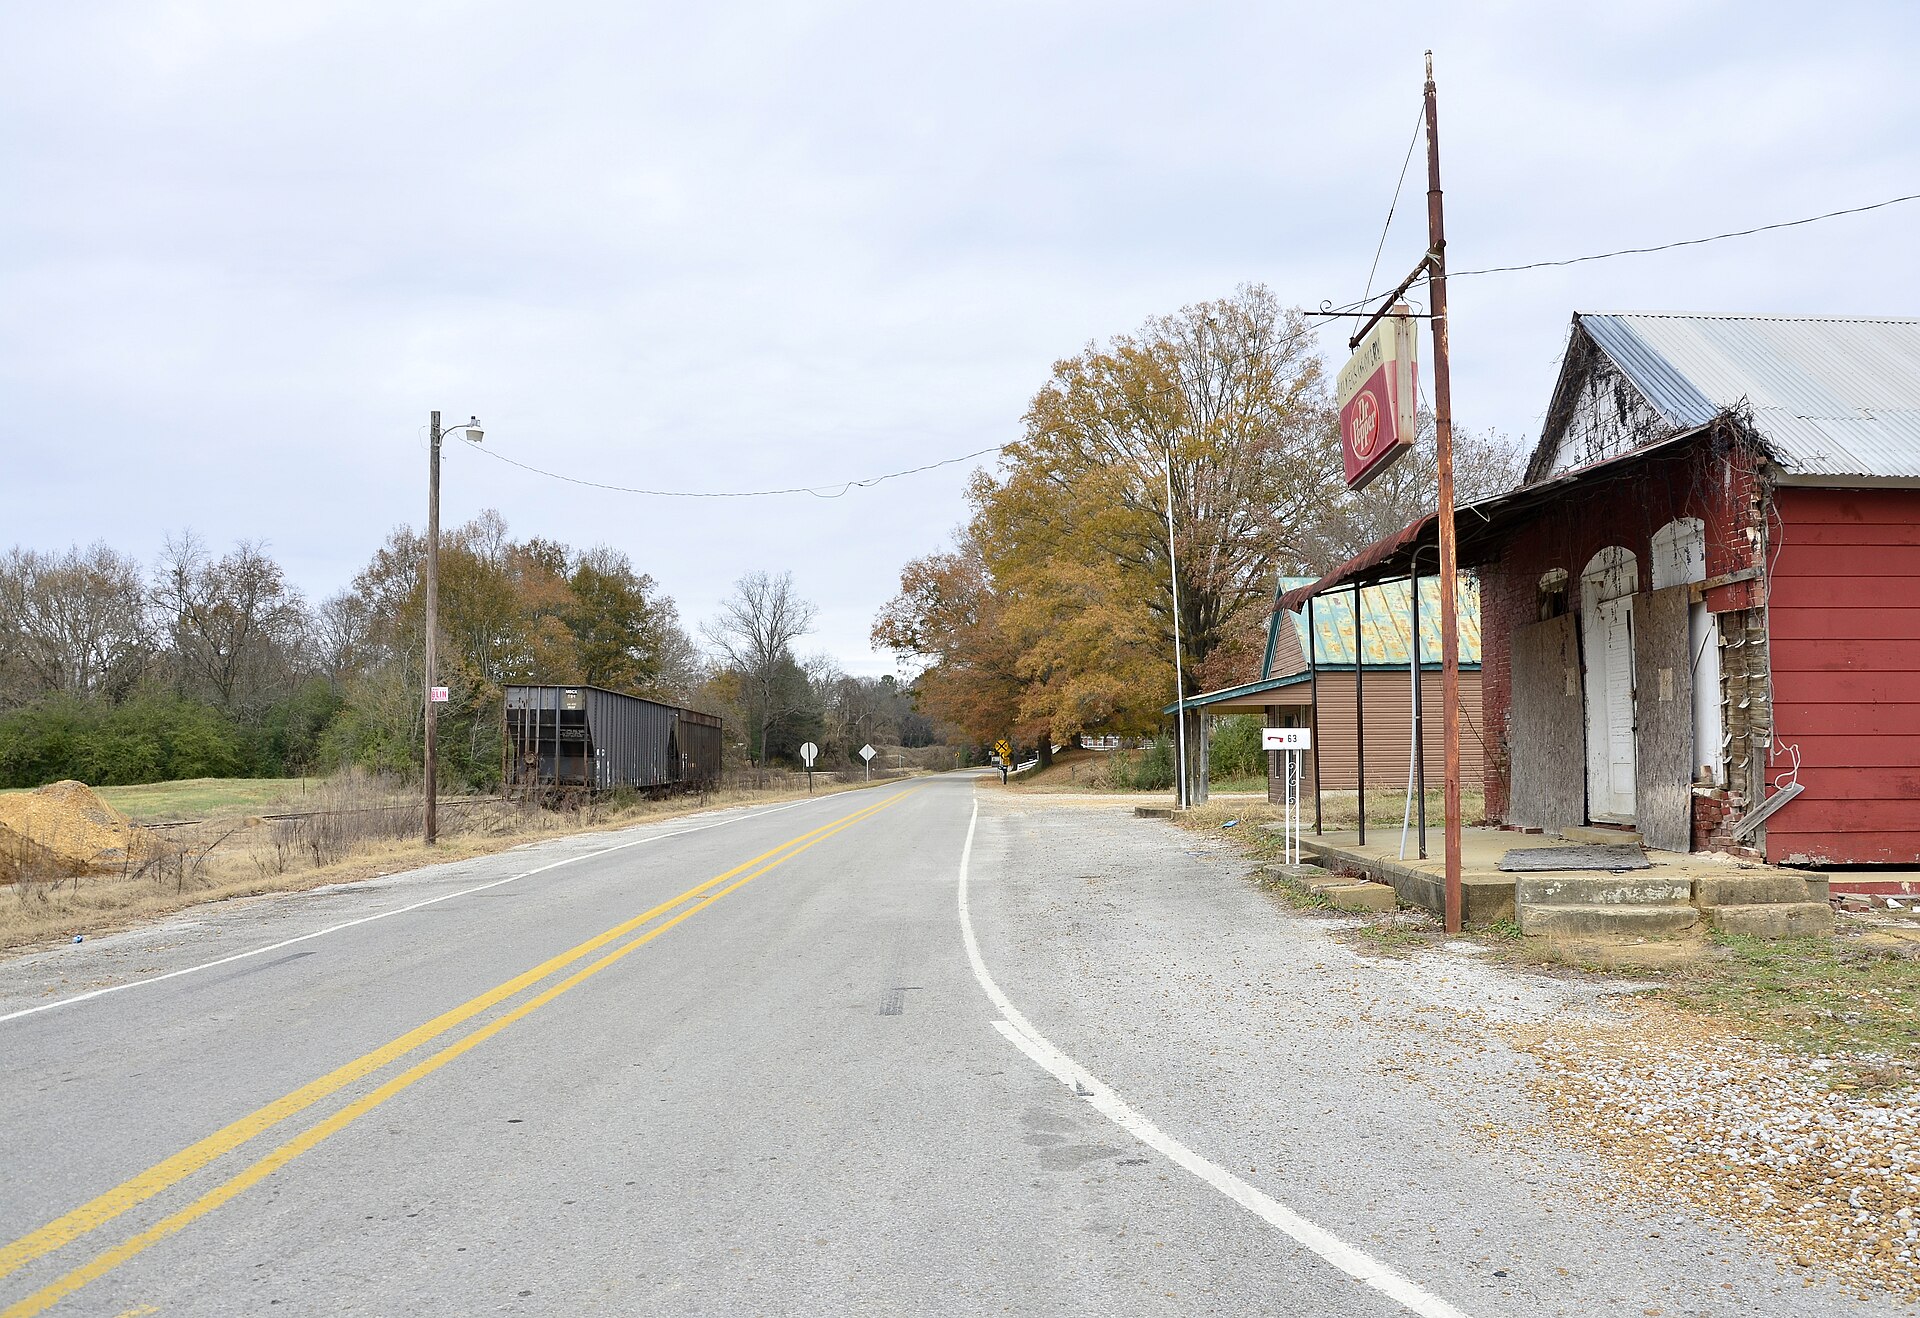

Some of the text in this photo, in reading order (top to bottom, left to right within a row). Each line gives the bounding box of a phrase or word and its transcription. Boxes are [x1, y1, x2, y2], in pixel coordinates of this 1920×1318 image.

[1358, 398, 1369, 422] Dr
[1352, 411, 1376, 452] Pepper
[1288, 734, 1297, 743] 63
